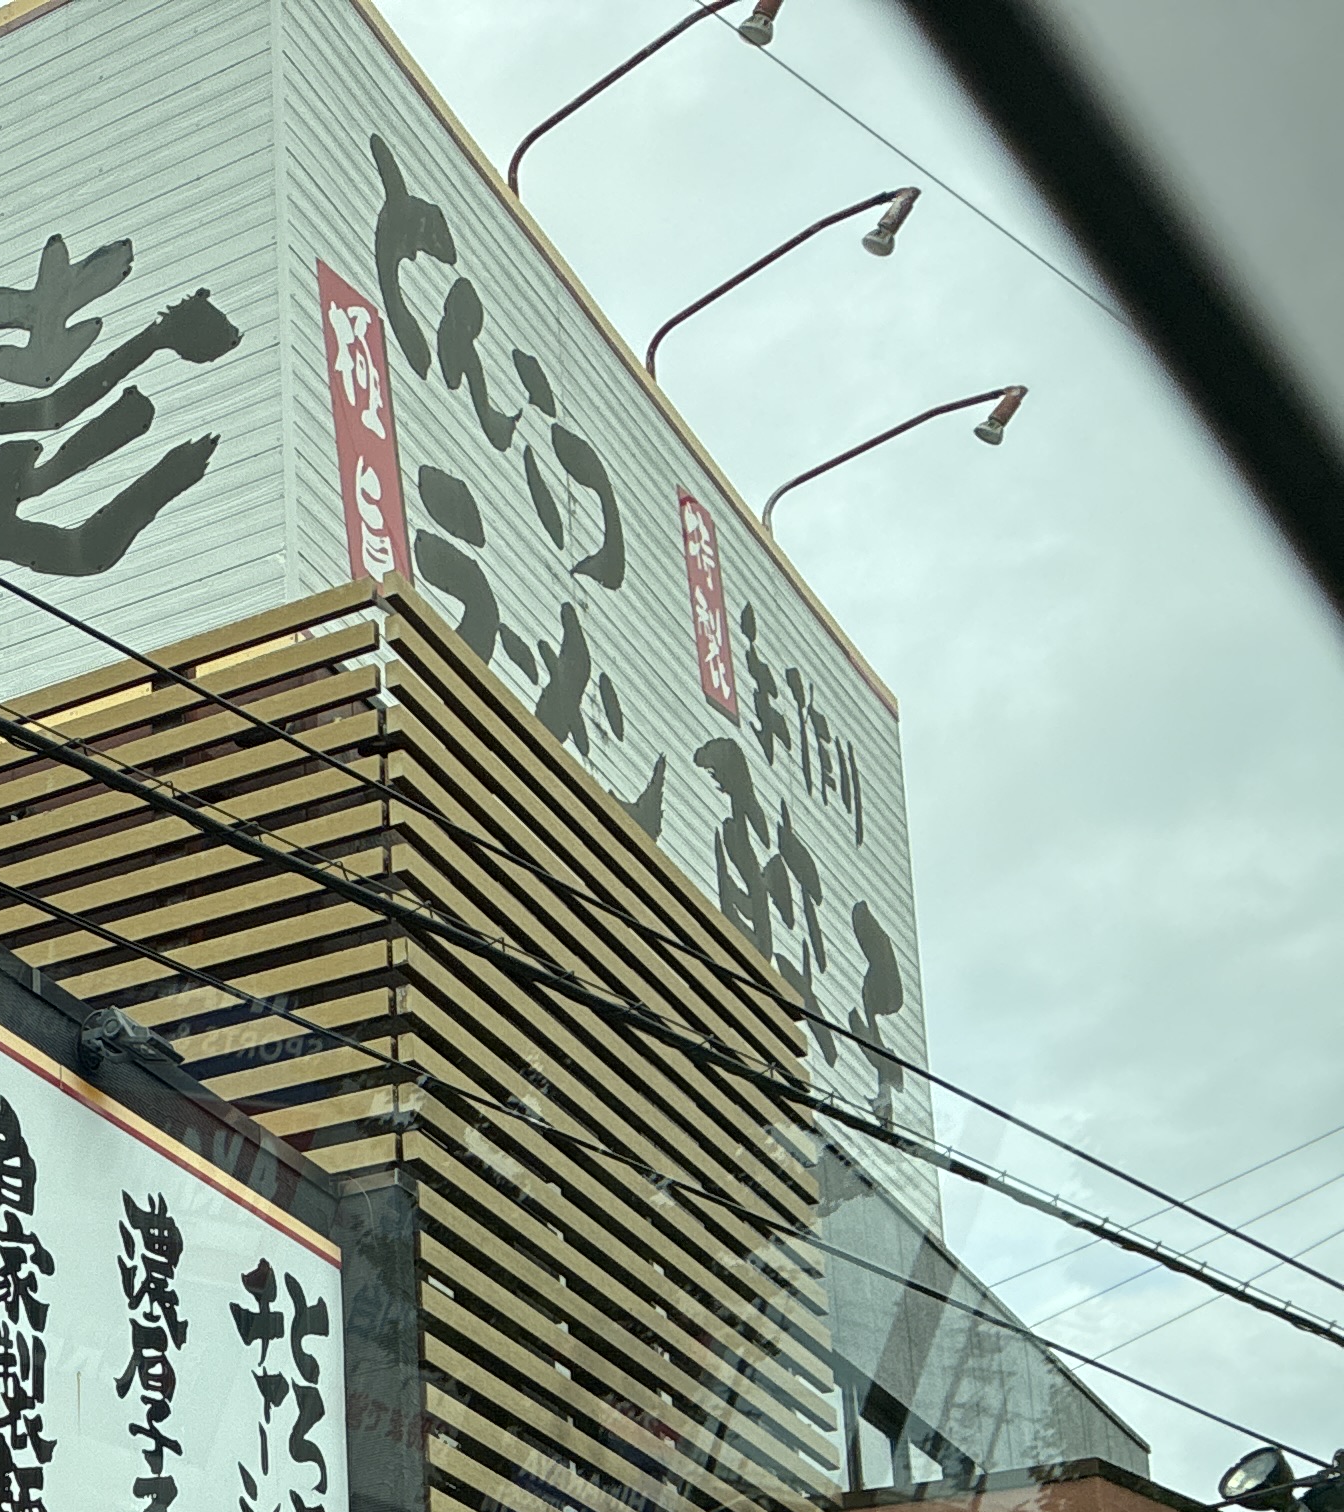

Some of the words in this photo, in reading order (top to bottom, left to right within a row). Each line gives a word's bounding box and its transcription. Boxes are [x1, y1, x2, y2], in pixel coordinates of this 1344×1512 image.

[326, 297, 396, 580] 極旨
[369, 133, 626, 590] とんこつ
[683, 502, 732, 698] 特製
[740, 600, 866, 848] 手作り
